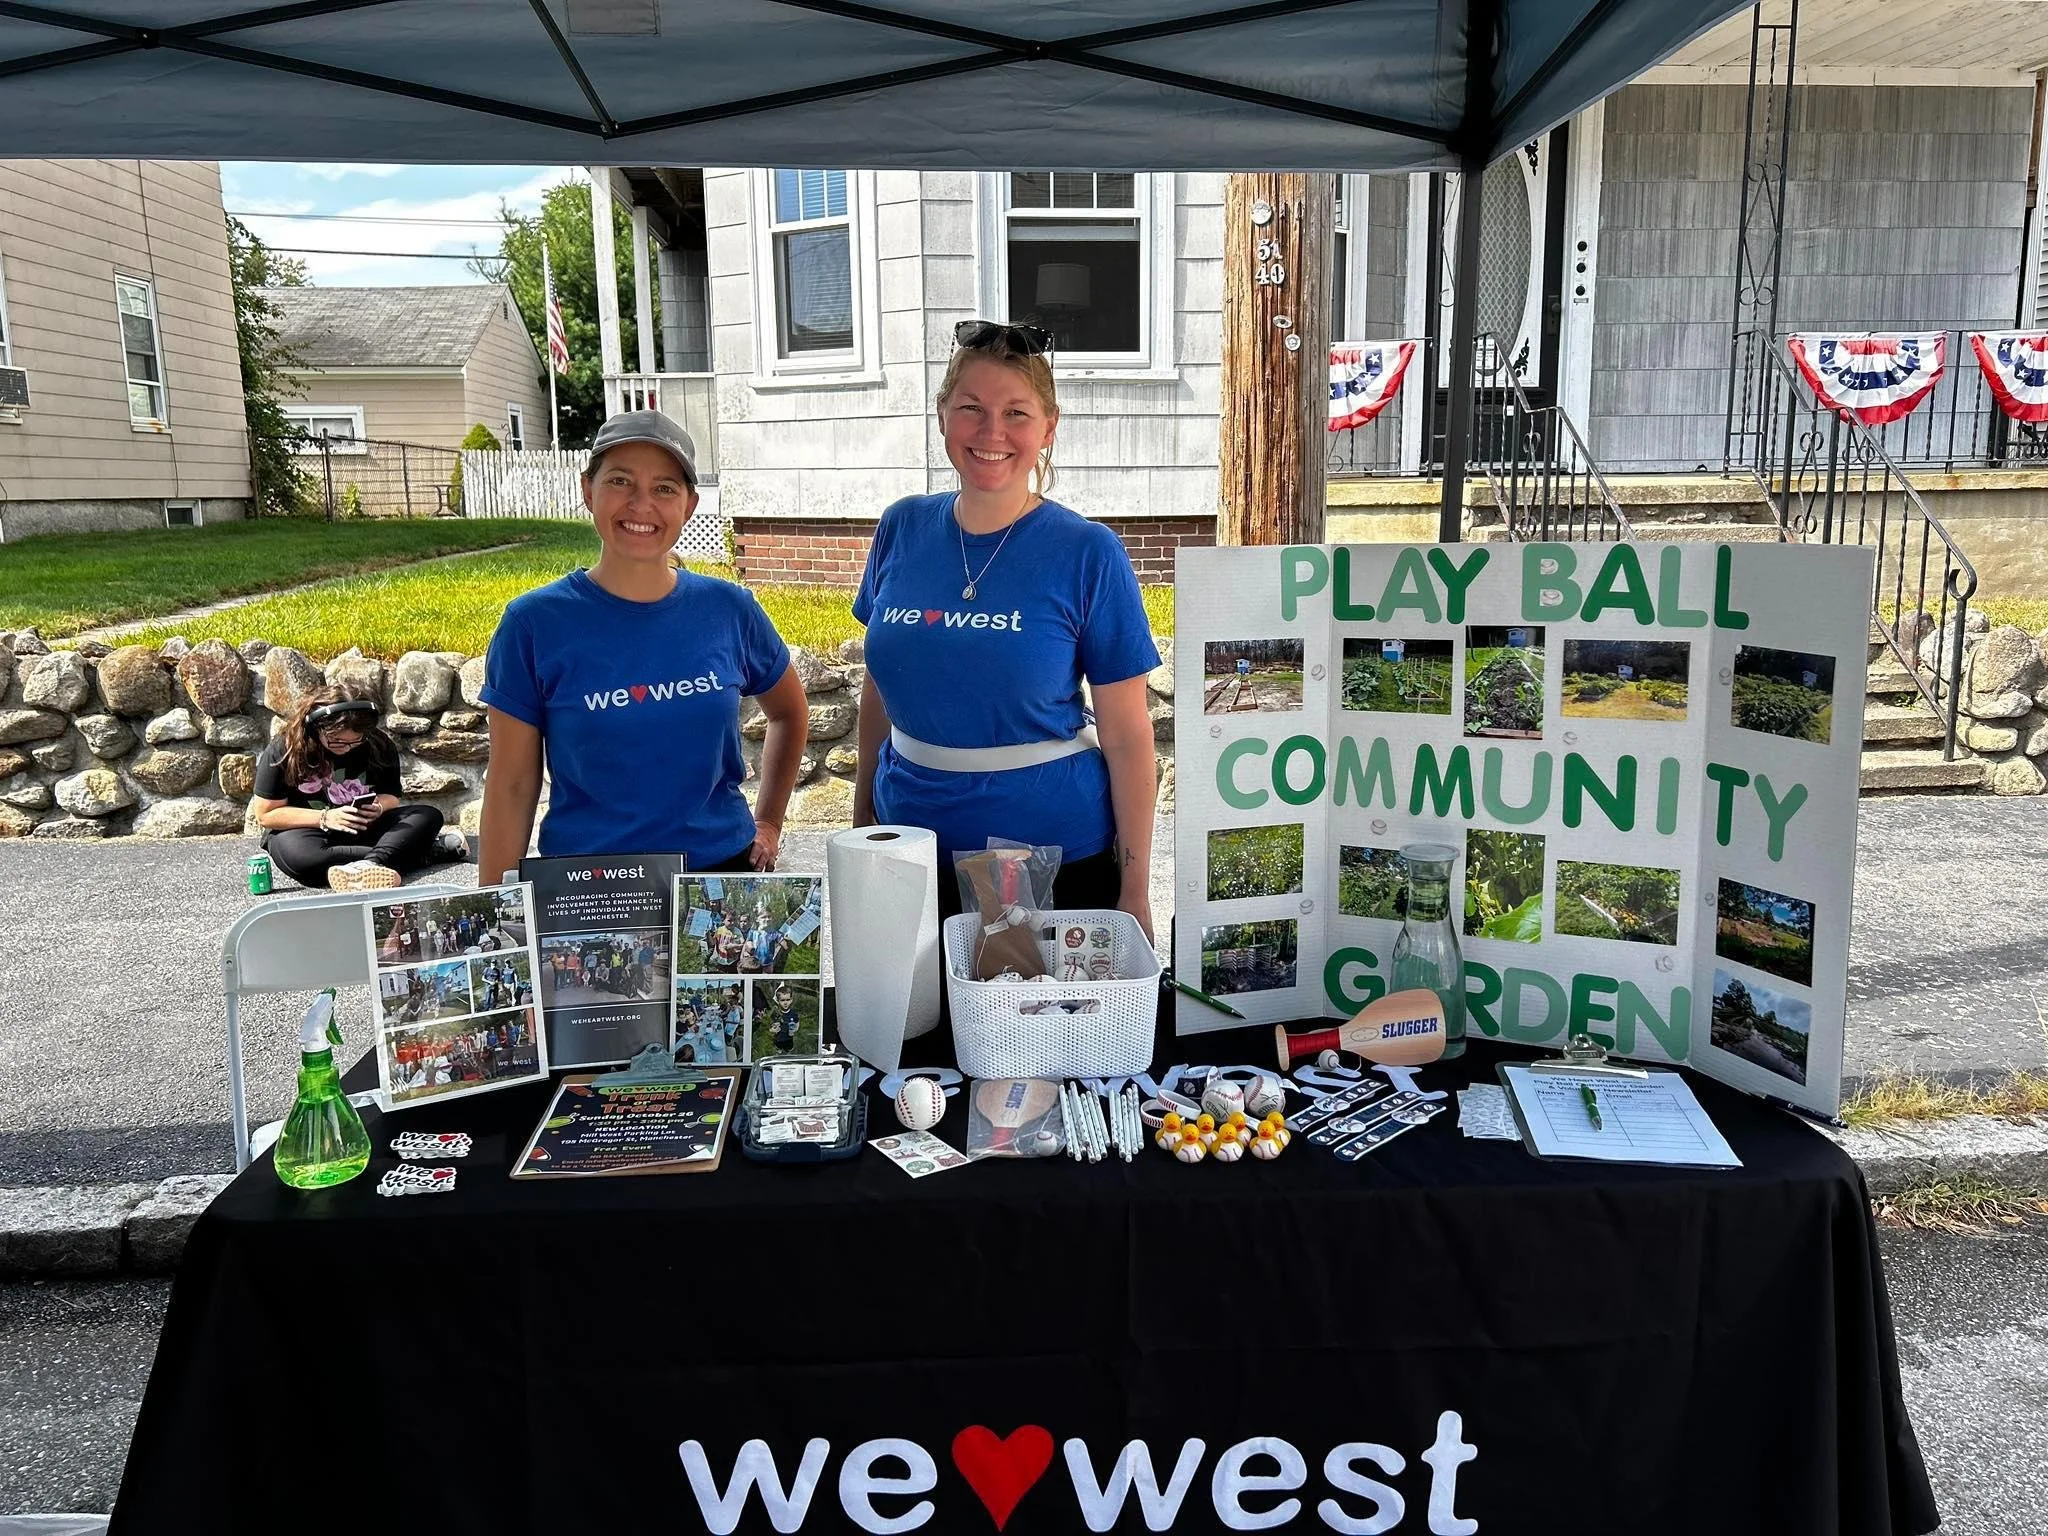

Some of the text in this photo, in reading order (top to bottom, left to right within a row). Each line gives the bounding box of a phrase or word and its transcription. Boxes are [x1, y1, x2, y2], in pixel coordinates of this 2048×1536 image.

[1255, 263, 1285, 285] 40
[1280, 543, 1749, 630] PLAY BALL
[882, 606, 1022, 632] we west
[584, 670, 724, 711] we west
[1216, 735, 1809, 862] COMMUNITY
[567, 864, 646, 882] we west
[555, 893, 609, 901] ENCOURAGING
[547, 901, 599, 909] INVOLVEMENT
[582, 906, 630, 914] INDIVIDUALS
[571, 1014, 641, 1025] WEHEARTWEST.ORG
[1381, 1017, 1438, 1039] SLUGGER
[646, 1084, 690, 1092] west
[608, 1092, 682, 1101] Trunk
[602, 1102, 677, 1113] Treat
[579, 1114, 624, 1122] Sunday
[678, 1410, 1479, 1536] we west
